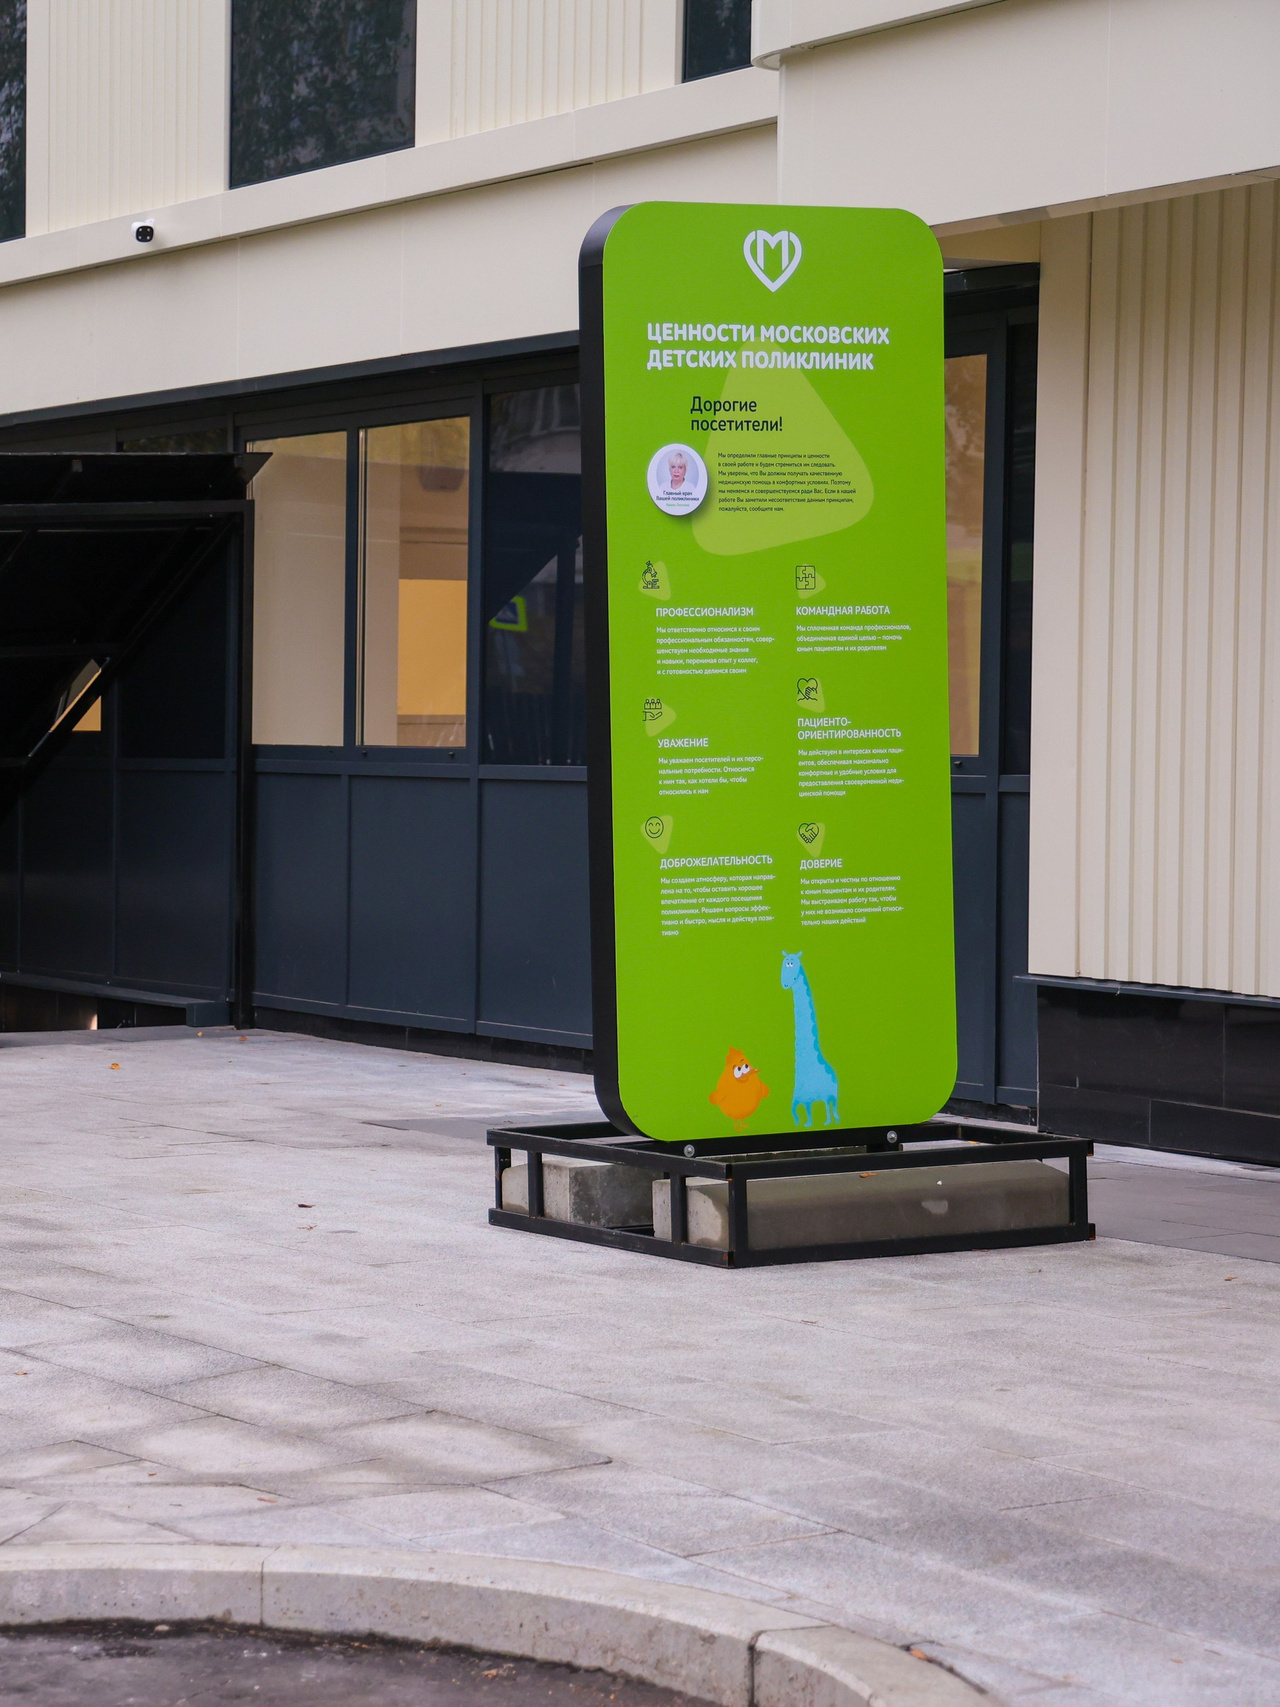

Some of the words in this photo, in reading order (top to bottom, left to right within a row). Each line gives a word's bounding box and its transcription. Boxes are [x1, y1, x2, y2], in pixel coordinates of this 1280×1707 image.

[647, 323, 755, 345] ЦЕННОСТИ
[760, 325, 890, 345] МОСКОВСКИХ
[646, 349, 737, 371] ДЕТСКИХ
[742, 351, 874, 370] ПОЛИКЛИНИК
[690, 396, 757, 416] Дорогие
[656, 607, 754, 617] ПРОФЕССИОНАЛИЗМ
[796, 605, 854, 617] КОМАНДНАЯ
[855, 605, 890, 615] РАБОТА
[797, 717, 852, 728] ПАЦИЕНТО-
[797, 728, 902, 740] ОРИЕНТИРОВАННОСТЬ
[657, 737, 709, 748] УВАЖЕНИЕ
[659, 855, 773, 869] ДОБРОЖЕЛАТЕЛЬНОСТЬ
[799, 858, 843, 870] ДОВЕРИЕ
